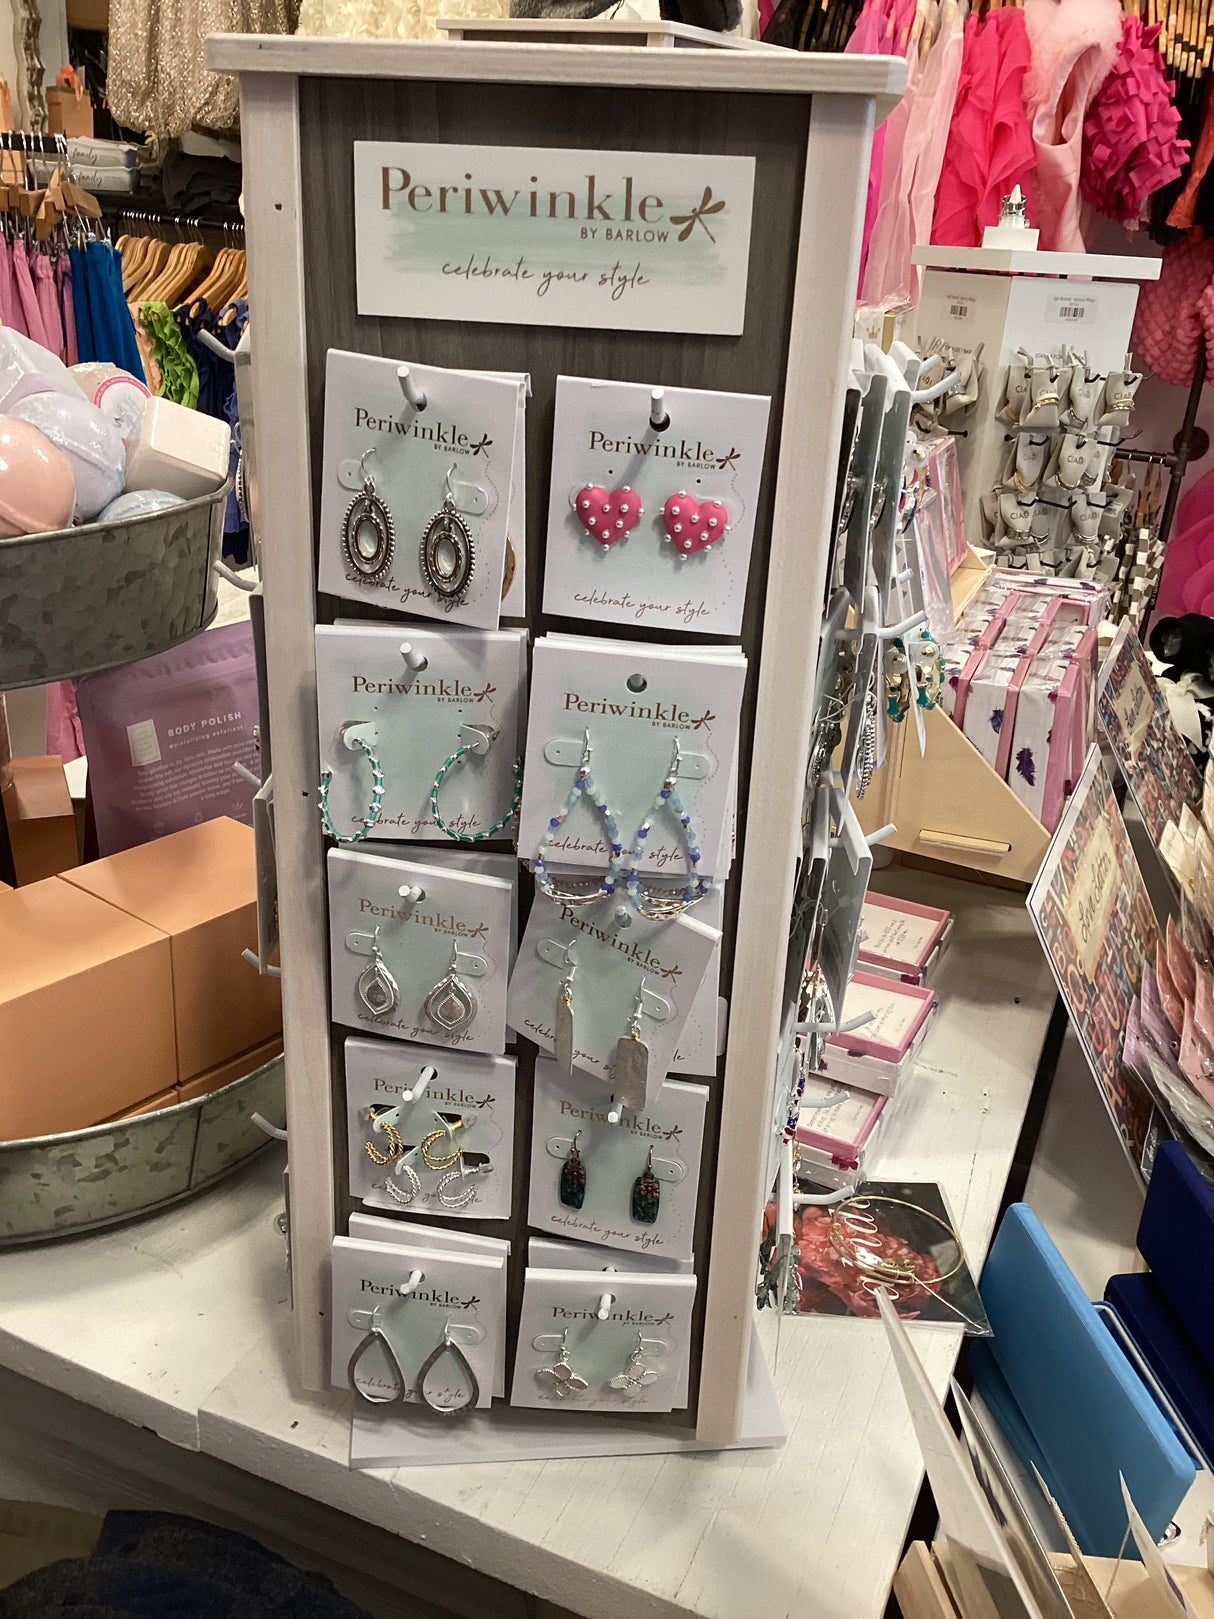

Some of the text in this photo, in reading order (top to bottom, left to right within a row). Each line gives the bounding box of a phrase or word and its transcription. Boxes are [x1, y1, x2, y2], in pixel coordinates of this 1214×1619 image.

[380, 165, 665, 225] Periwinkle
[580, 227, 669, 243] BY BARLOW
[442, 254, 651, 301] celebrate your style
[354, 407, 469, 447] Periwinkle
[444, 445, 470, 456] BARLOW
[589, 430, 715, 462] Periwinkle
[687, 462, 716, 470] BARLOW
[400, 585, 433, 603] your
[574, 589, 711, 624] celebrate your style
[351, 676, 472, 697] Periwinkle
[563, 692, 690, 724] Periwinkle
[167, 711, 242, 737] BODY POLISH
[662, 722, 691, 730] BARLOW
[351, 813, 481, 834] cebrate you style
[648, 846, 684, 868] style
[358, 897, 467, 932] Periwinkle
[443, 928, 469, 937] BARLOW
[559, 906, 662, 969] Periwinkle
[636, 962, 660, 976] BARLOW
[357, 1012, 410, 1031] celebrate
[524, 1018, 556, 1041] celebr
[559, 1100, 661, 1134] Periwnkle
[551, 1214, 664, 1249] celebrate your style
[552, 1306, 654, 1321] Periwnkle
[355, 1376, 400, 1390] celebrat
